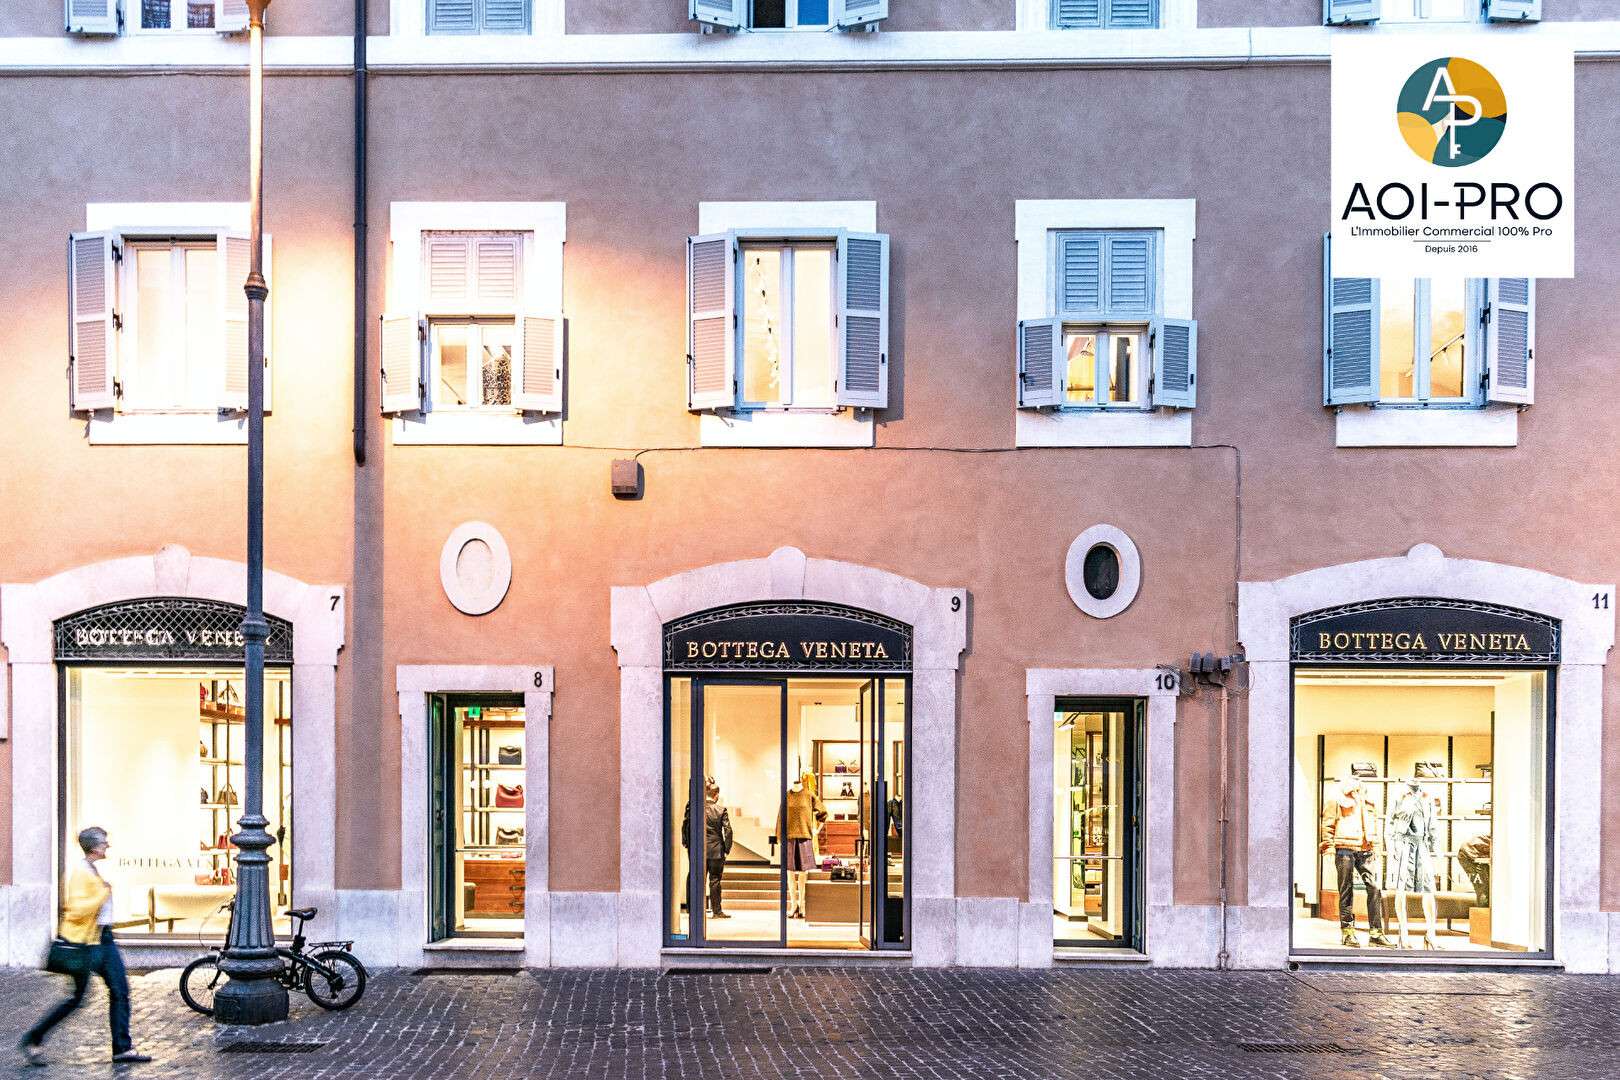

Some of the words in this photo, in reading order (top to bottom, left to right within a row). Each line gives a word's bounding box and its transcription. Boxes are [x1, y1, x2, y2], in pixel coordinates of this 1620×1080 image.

[330, 595, 341, 611] 7
[951, 596, 961, 612] 9
[1591, 592, 1609, 609] 11
[76, 629, 174, 646] BOTTEGA
[186, 629, 271, 646] VENE
[1318, 632, 1428, 650] BOTTEGA
[1438, 632, 1532, 650] VENETA
[686, 641, 790, 658] BOTTEGA
[800, 641, 889, 659] VENETA
[534, 671, 543, 688] 8
[1155, 673, 1175, 690] 10
